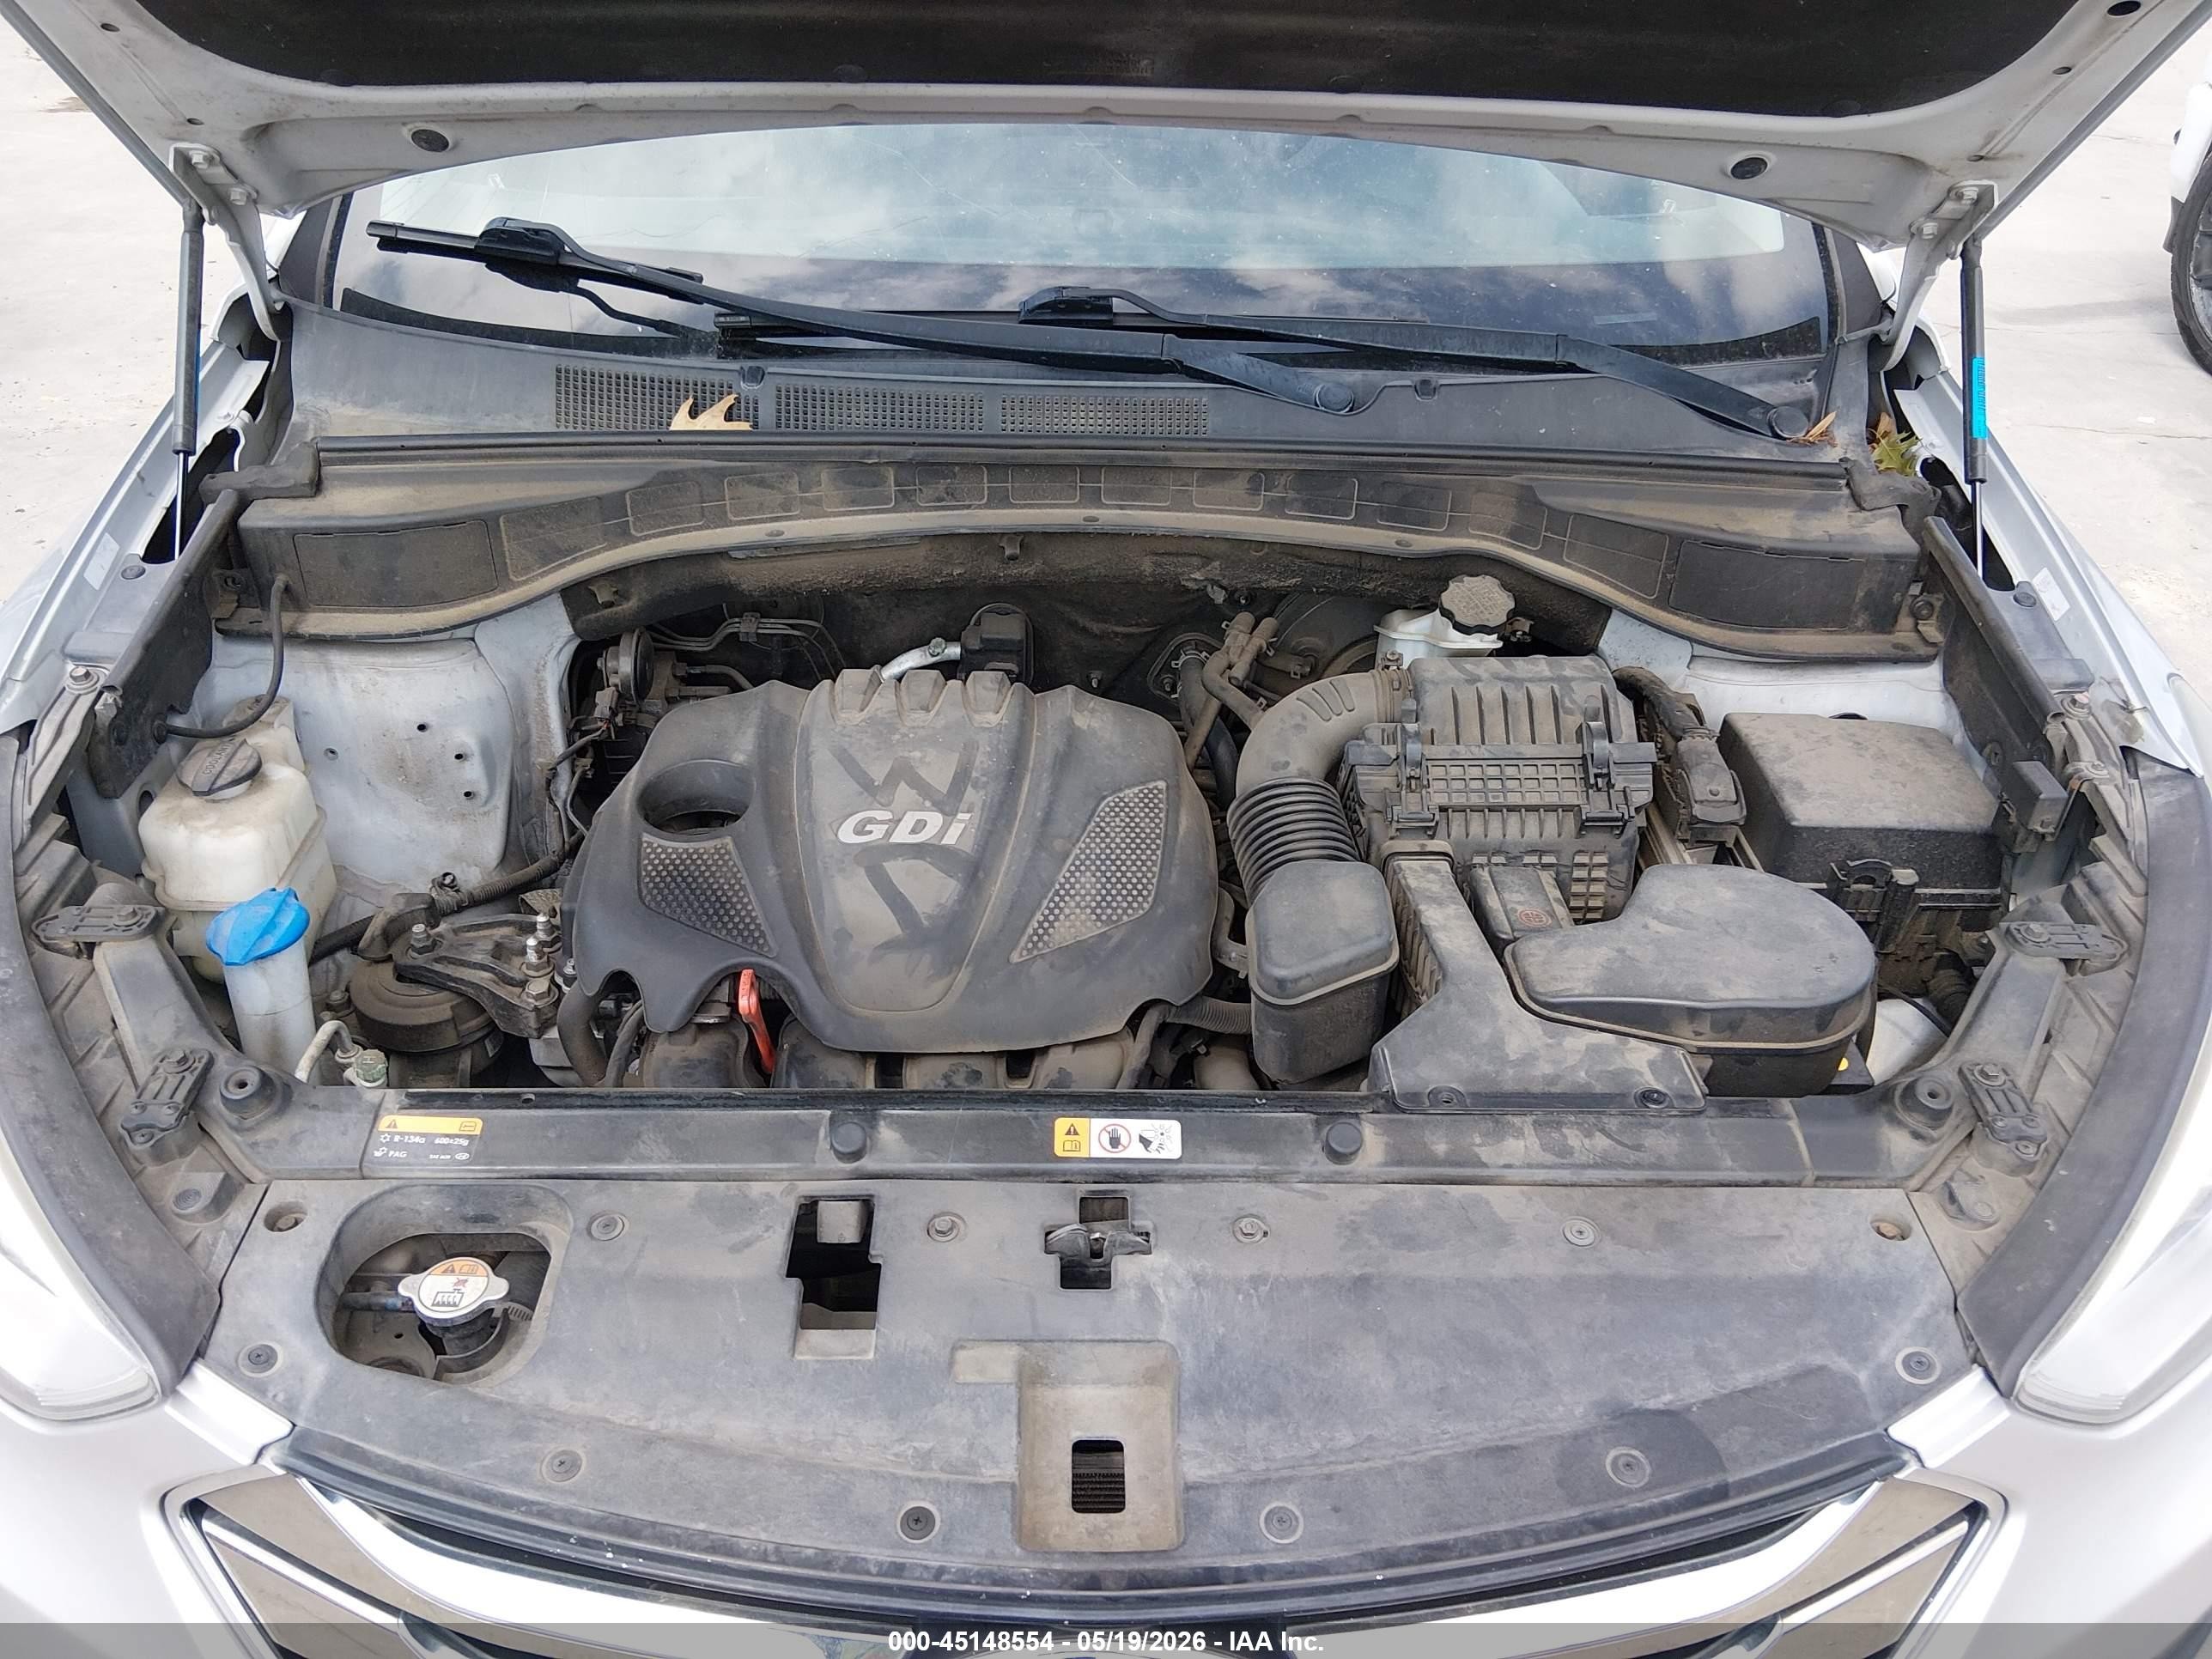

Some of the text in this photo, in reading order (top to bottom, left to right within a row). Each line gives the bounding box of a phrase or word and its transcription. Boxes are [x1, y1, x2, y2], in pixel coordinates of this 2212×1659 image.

[837, 810, 973, 846] GDi
[393, 1134, 427, 1145] R-134a
[388, 1150, 408, 1158] PAG
